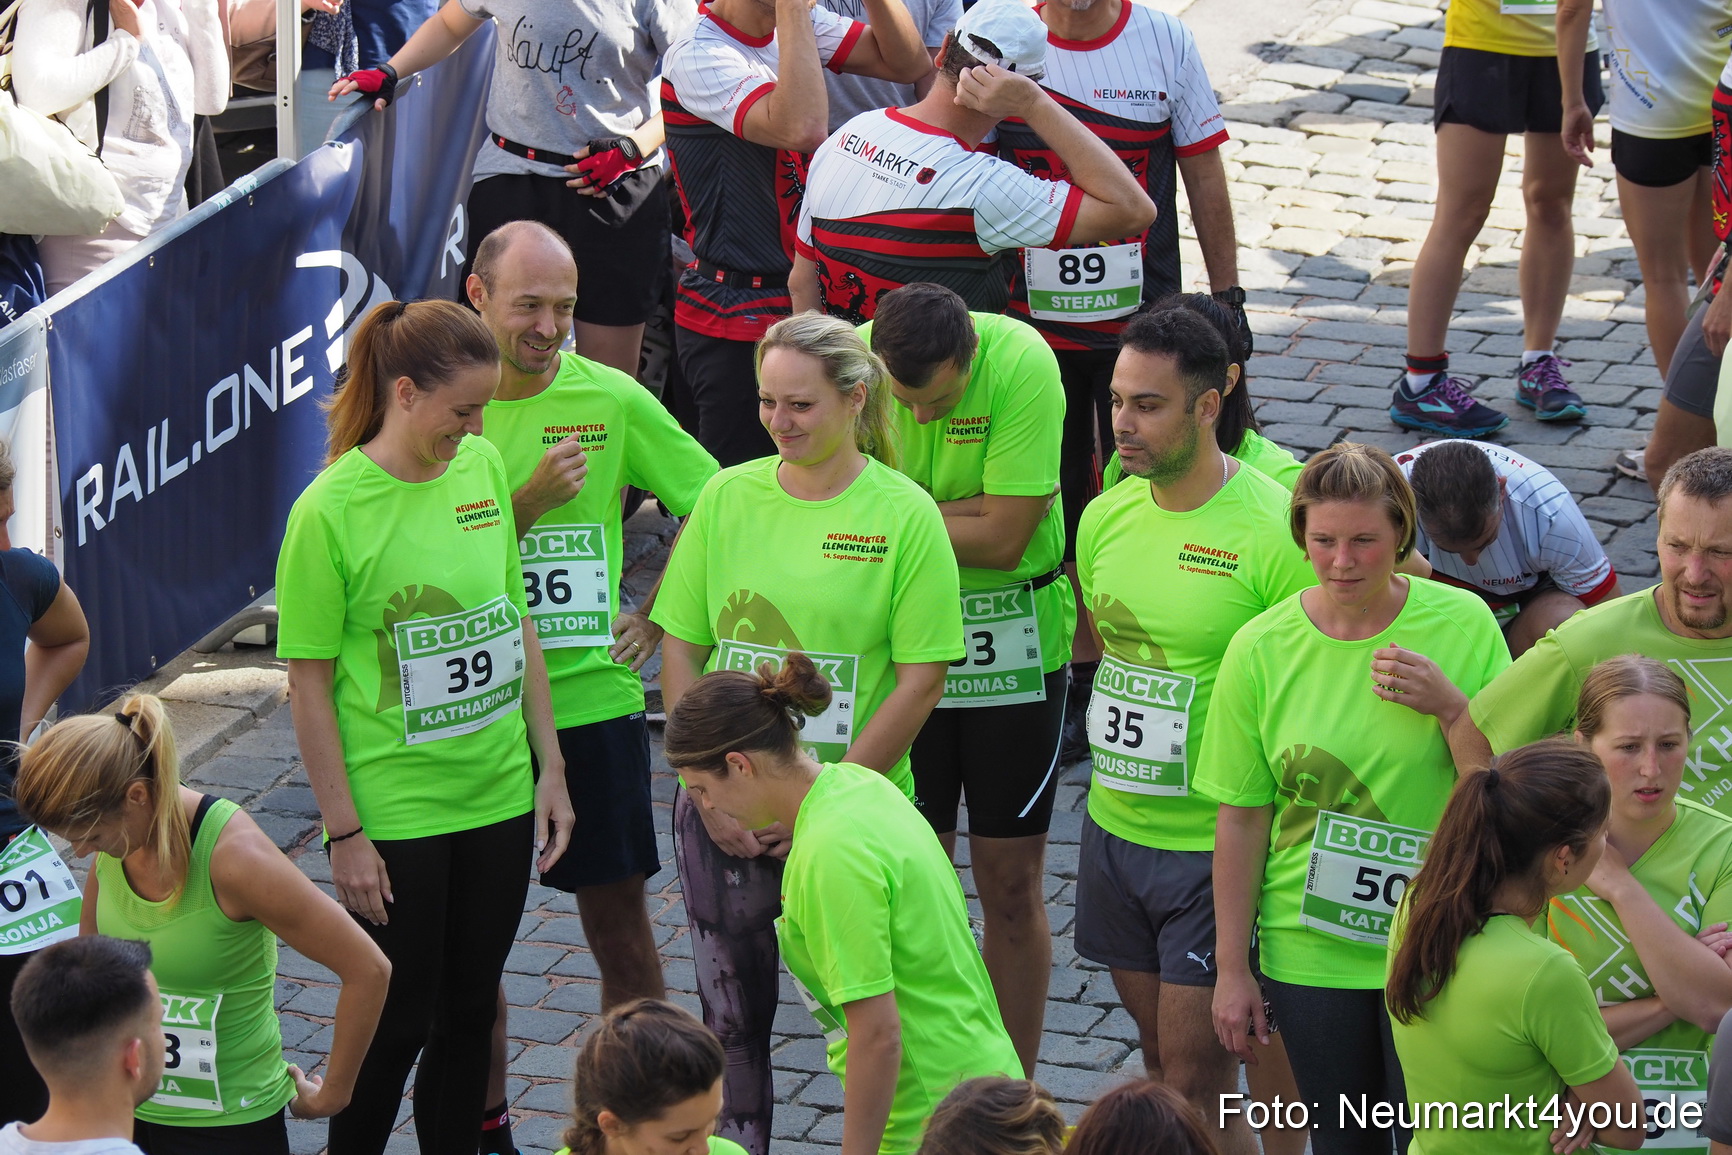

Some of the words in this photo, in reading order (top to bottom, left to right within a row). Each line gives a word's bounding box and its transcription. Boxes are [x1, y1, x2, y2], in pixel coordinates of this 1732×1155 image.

[1094, 89, 1156, 100] NEUMARKT
[836, 132, 919, 177] NEUMARKT
[1058, 252, 1106, 286] 89
[1051, 293, 1118, 310] STEFAN
[76, 324, 314, 548] RAIL.ONE
[542, 433, 608, 444] ELEMTELAUF
[544, 423, 605, 434] NEUMARKTER
[822, 542, 889, 555] ELEMENTELAUF
[827, 533, 887, 544] NEUMARKTER
[833, 553, 868, 562] September
[869, 556, 884, 564] 2019
[1178, 552, 1239, 571] ELEMENTELAUF
[1184, 543, 1239, 562] NEUMARKTER
[1186, 565, 1217, 576] September
[1482, 574, 1523, 587] NEUMA
[406, 601, 514, 656] BOCK
[445, 650, 493, 695] 39
[725, 646, 844, 687] BOK
[1097, 661, 1183, 707] BOCK
[420, 685, 513, 727] KATHARINA
[1104, 705, 1145, 749] 35
[1173, 722, 1183, 730] E6
[1093, 750, 1163, 781] YOUSSEF
[1352, 866, 1412, 909] 50
[0, 911, 63, 945] SONJA
